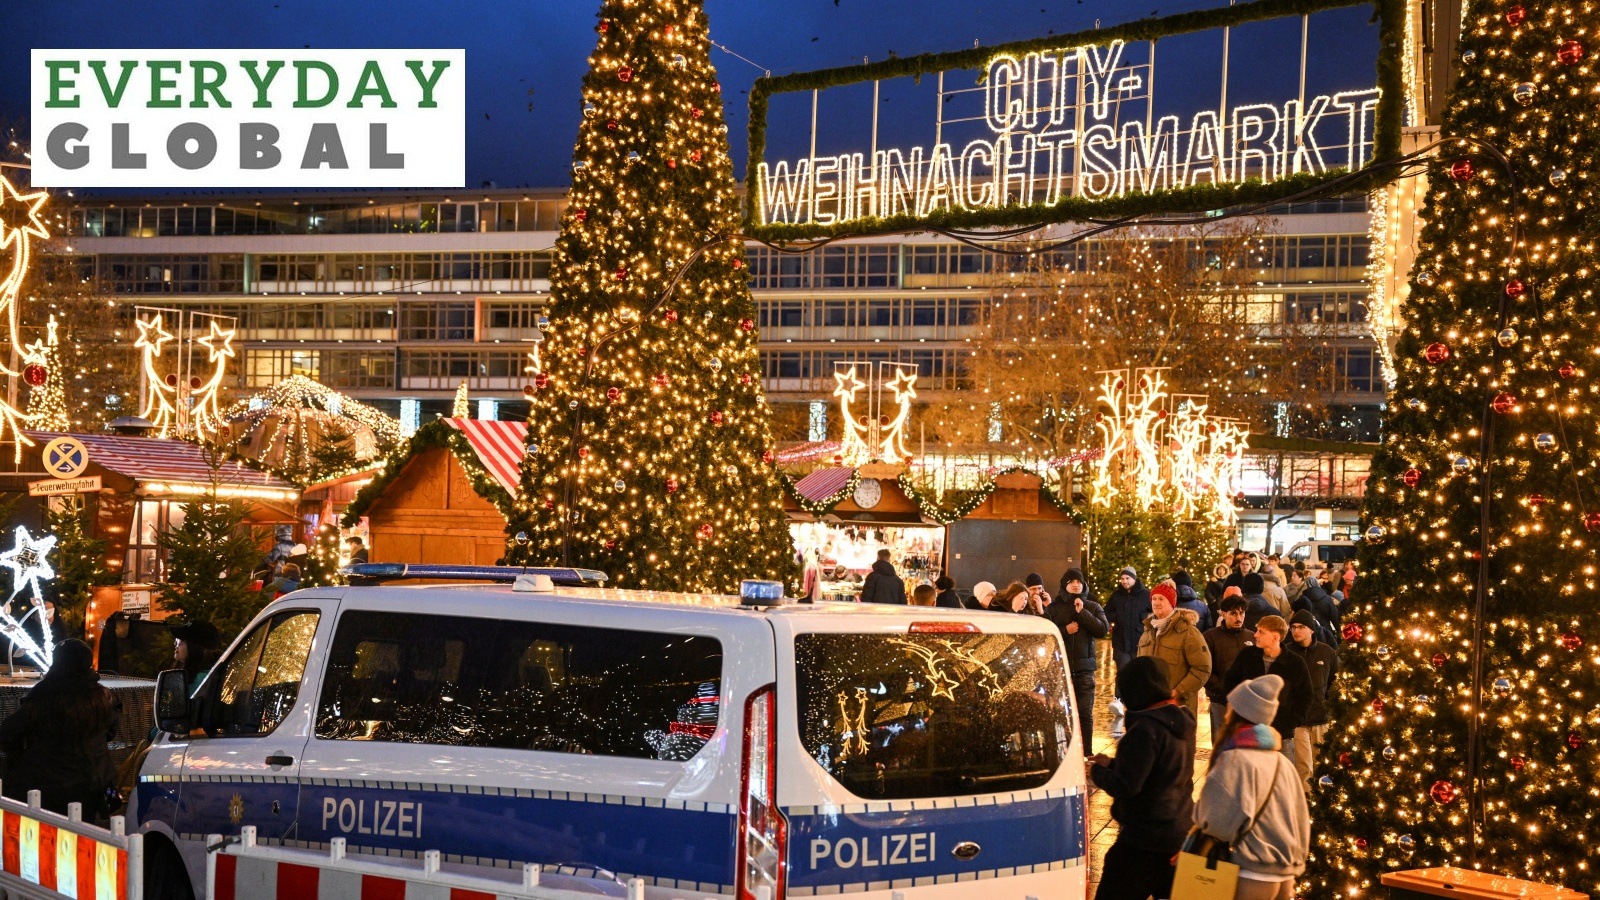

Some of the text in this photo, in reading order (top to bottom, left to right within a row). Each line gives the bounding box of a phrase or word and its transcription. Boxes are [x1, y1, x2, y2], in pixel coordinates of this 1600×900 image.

[985, 39, 1142, 134] CITY-
[757, 87, 1384, 226] WEIHNACHTSMARKT
[321, 796, 424, 839] POLIZEI
[809, 831, 936, 870] POLIZEI
